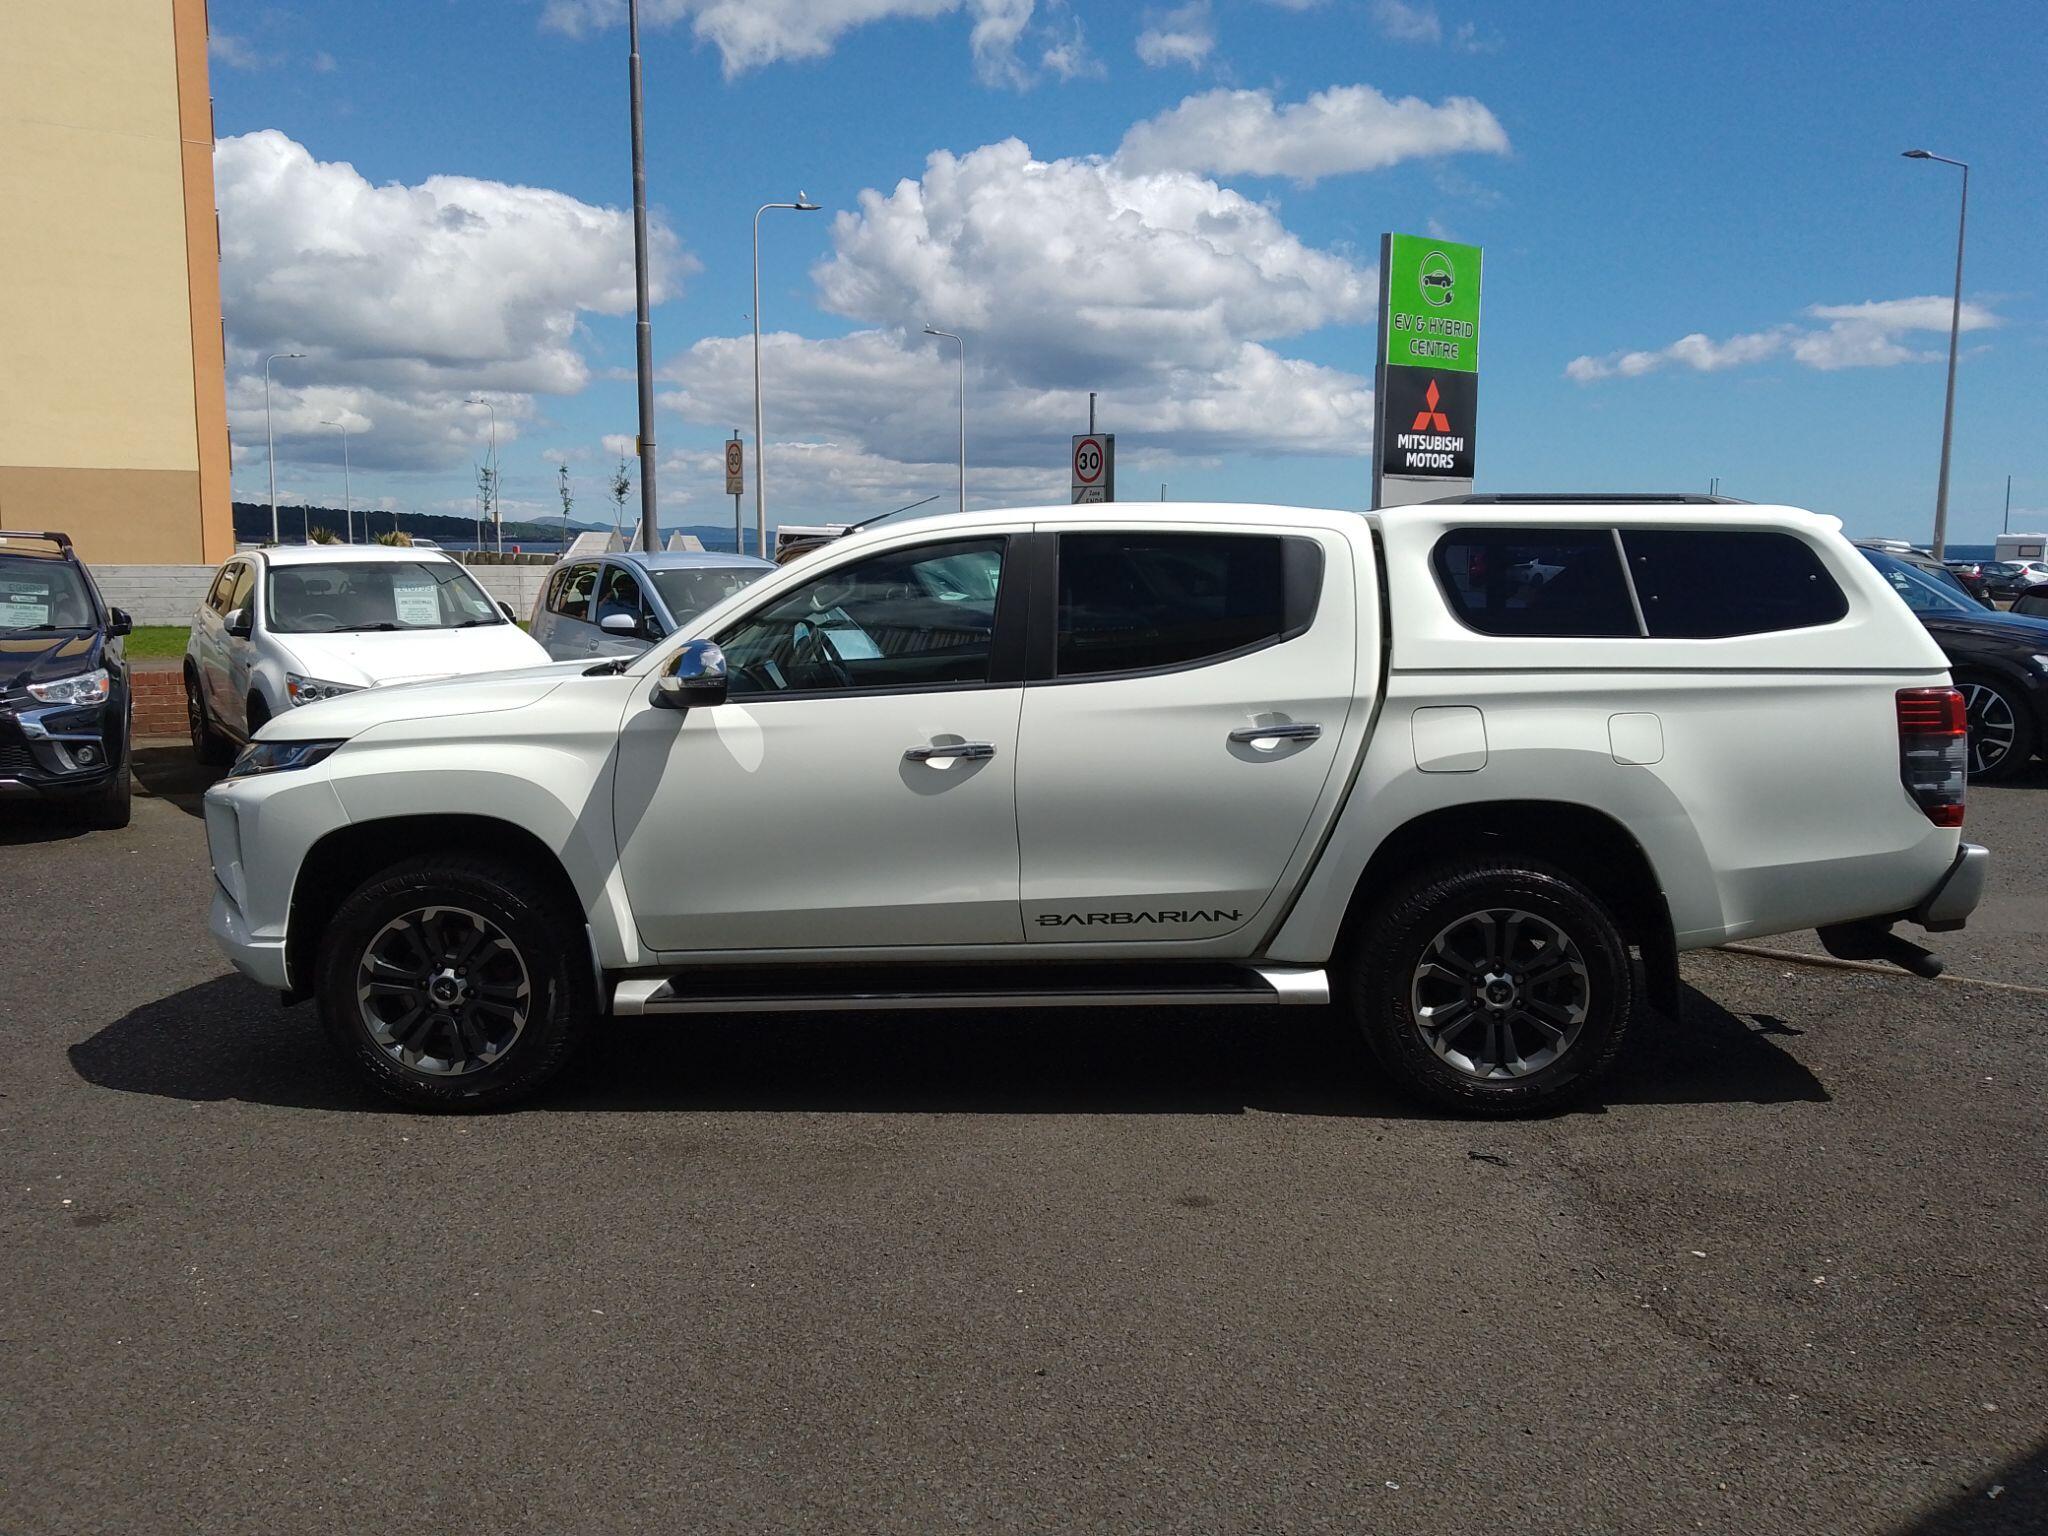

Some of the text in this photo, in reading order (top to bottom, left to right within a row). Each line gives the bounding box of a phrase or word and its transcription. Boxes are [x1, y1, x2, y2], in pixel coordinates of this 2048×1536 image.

[1394, 313, 1473, 337] EV & HYBRID
[1409, 339, 1458, 359] CENTRE
[1397, 434, 1464, 451] MITSUBISHI
[1079, 452, 1099, 470] 30
[1405, 452, 1455, 468] MOTORS
[1035, 910, 1243, 926] BARBARIAN
